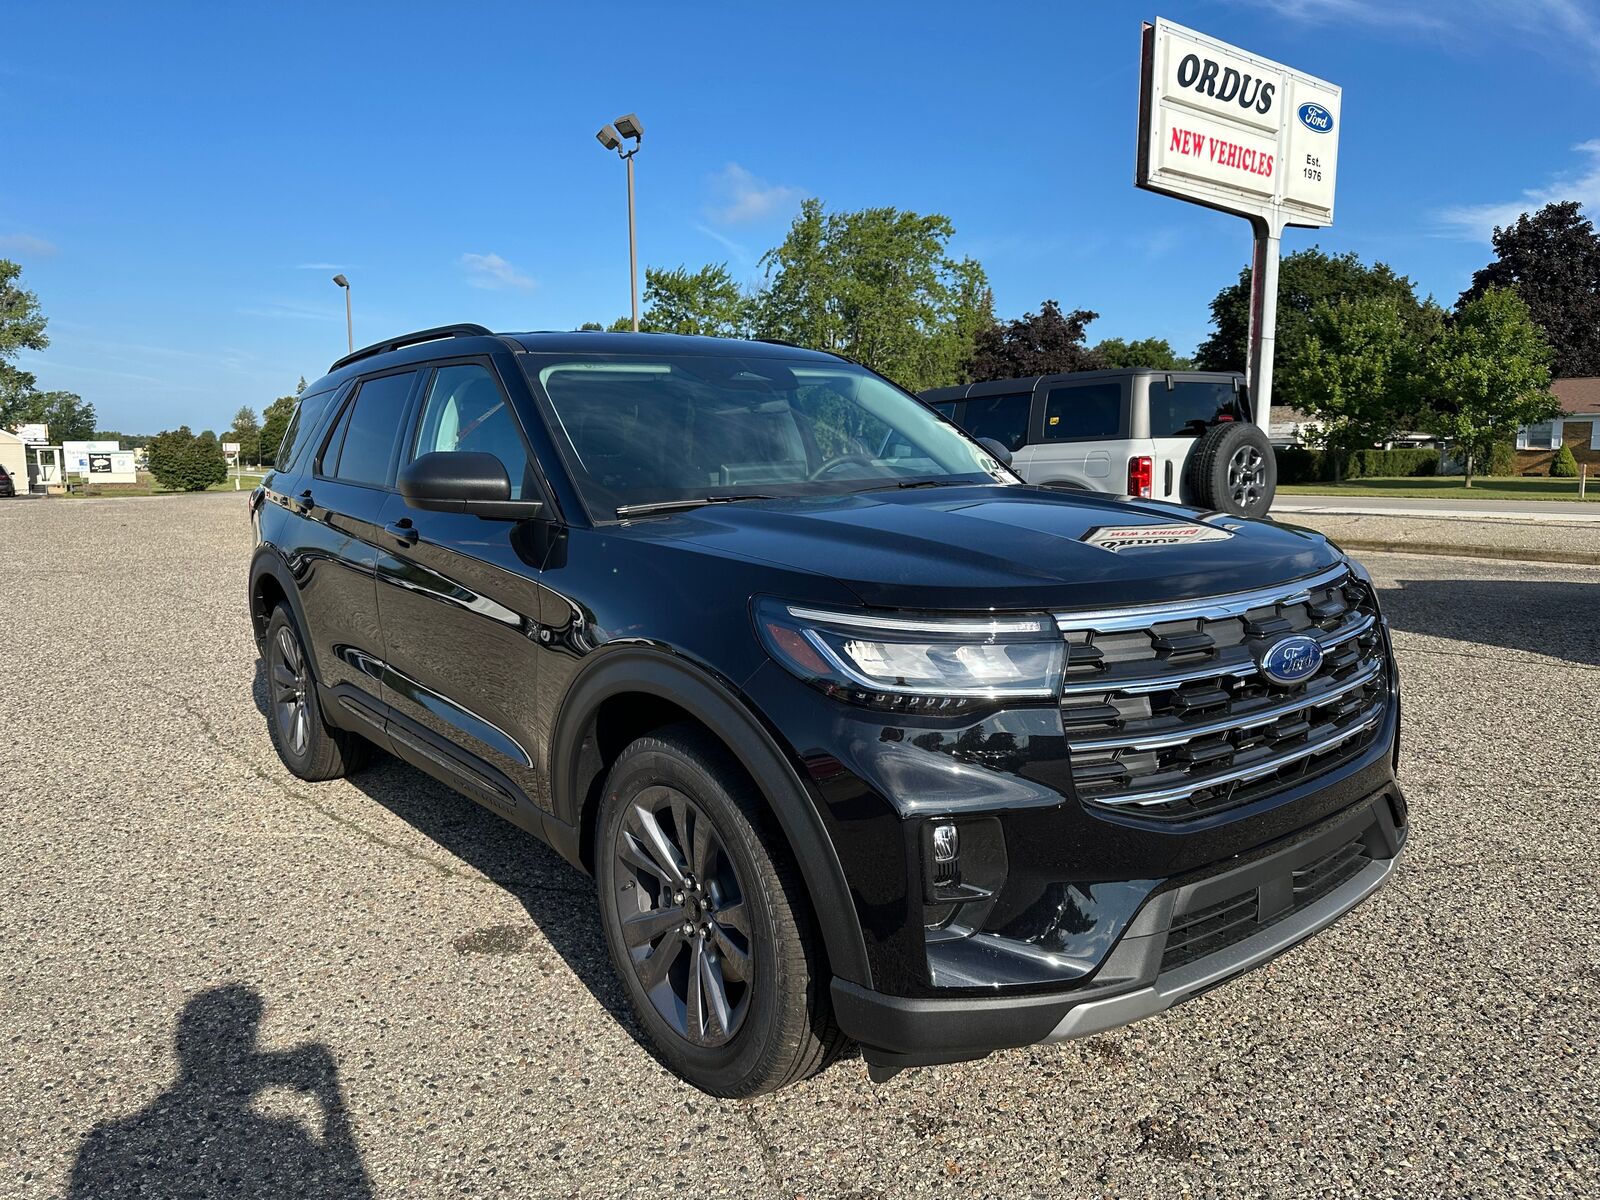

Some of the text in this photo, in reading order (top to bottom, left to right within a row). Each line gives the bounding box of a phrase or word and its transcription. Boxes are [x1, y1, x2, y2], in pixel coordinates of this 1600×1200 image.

[1177, 53, 1276, 115] ORDUS
[1305, 106, 1328, 127] Ford
[1169, 127, 1274, 178] NEW VEHICLES
[1306, 154, 1321, 168] Est.
[1303, 167, 1322, 182] 1976
[1283, 645, 1314, 674] Ford
